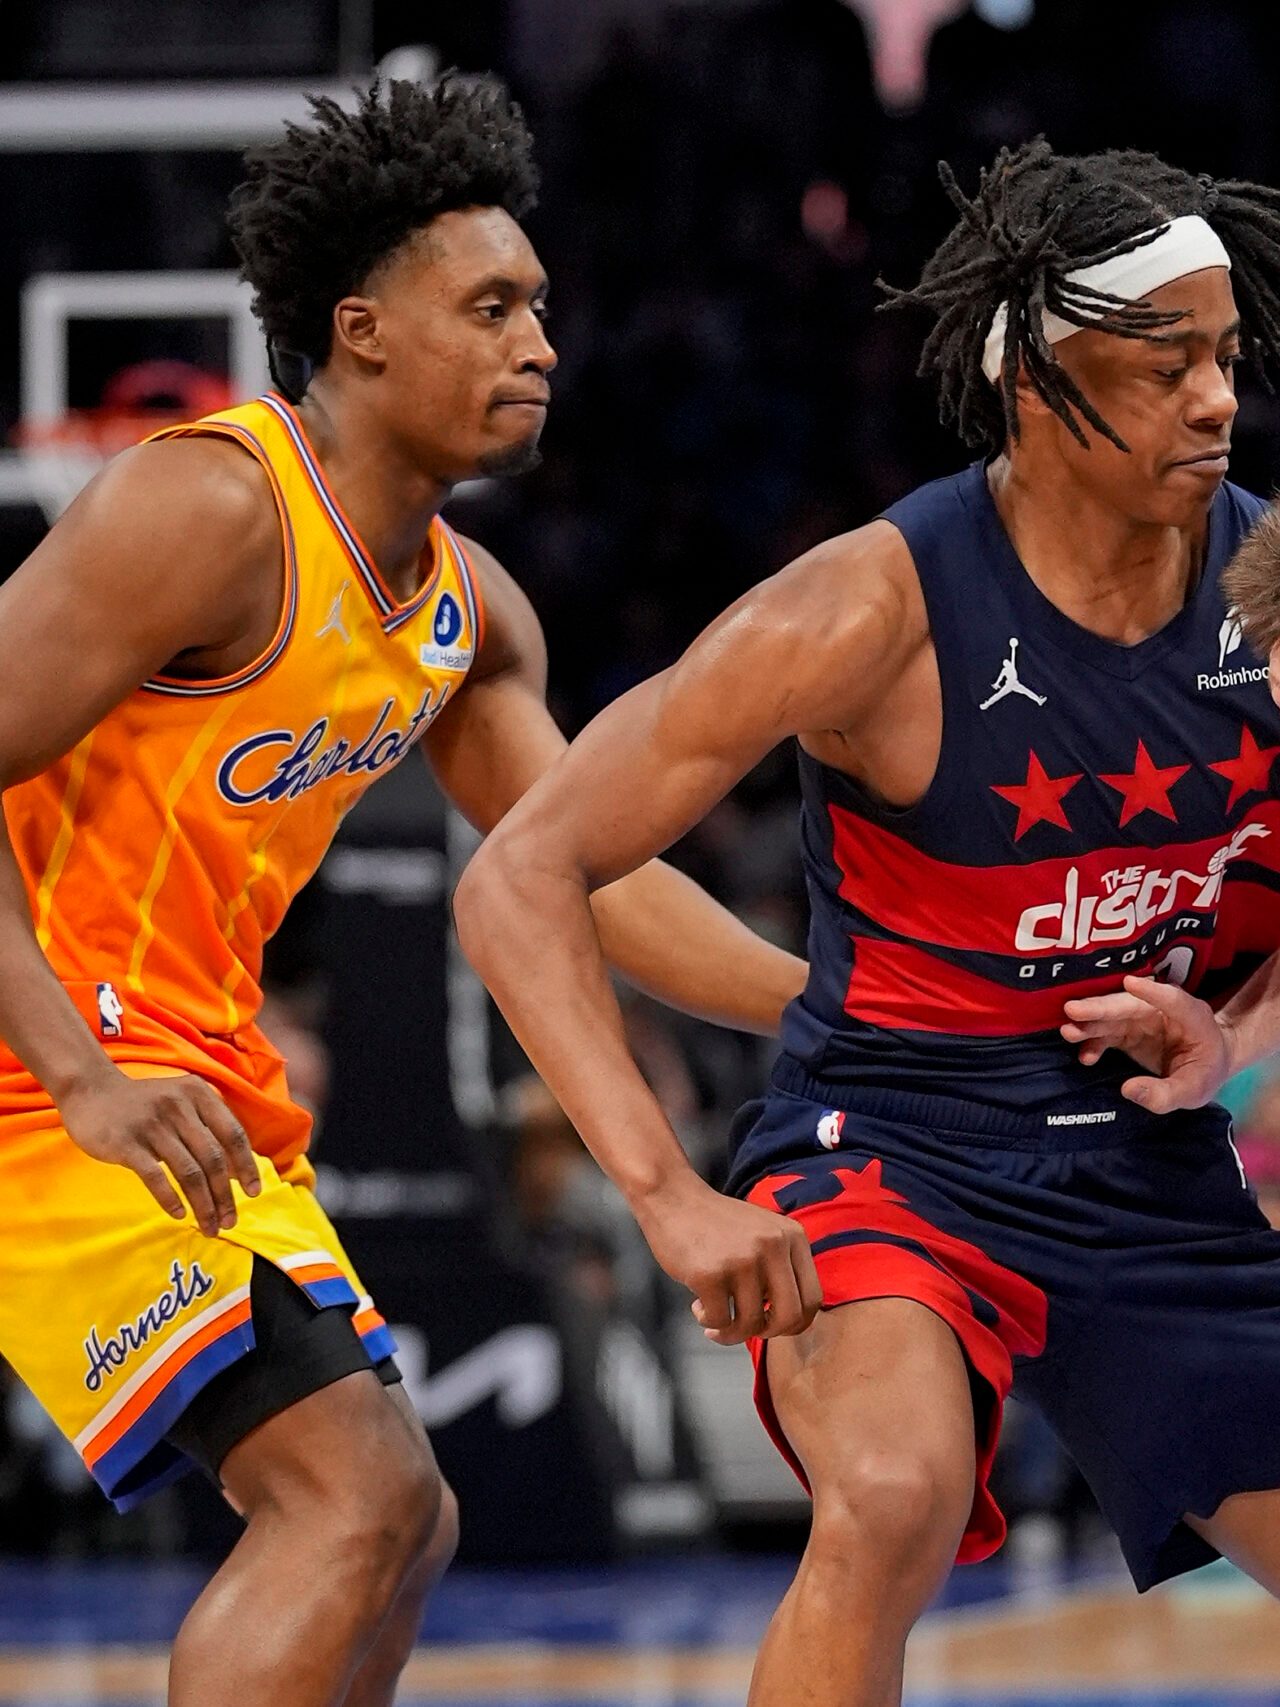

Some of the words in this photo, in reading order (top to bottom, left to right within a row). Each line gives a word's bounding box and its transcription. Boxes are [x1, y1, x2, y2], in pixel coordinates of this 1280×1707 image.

[1197, 666, 1270, 690] Robinhoo
[215, 682, 450, 807] Charlott
[1015, 844, 1232, 951] distri
[1101, 865, 1146, 894] THE
[1019, 963, 1065, 978] OF
[1095, 917, 1200, 968] COLUM
[1047, 1111, 1116, 1126] WASHINGTON
[83, 1258, 217, 1393] Hornets
